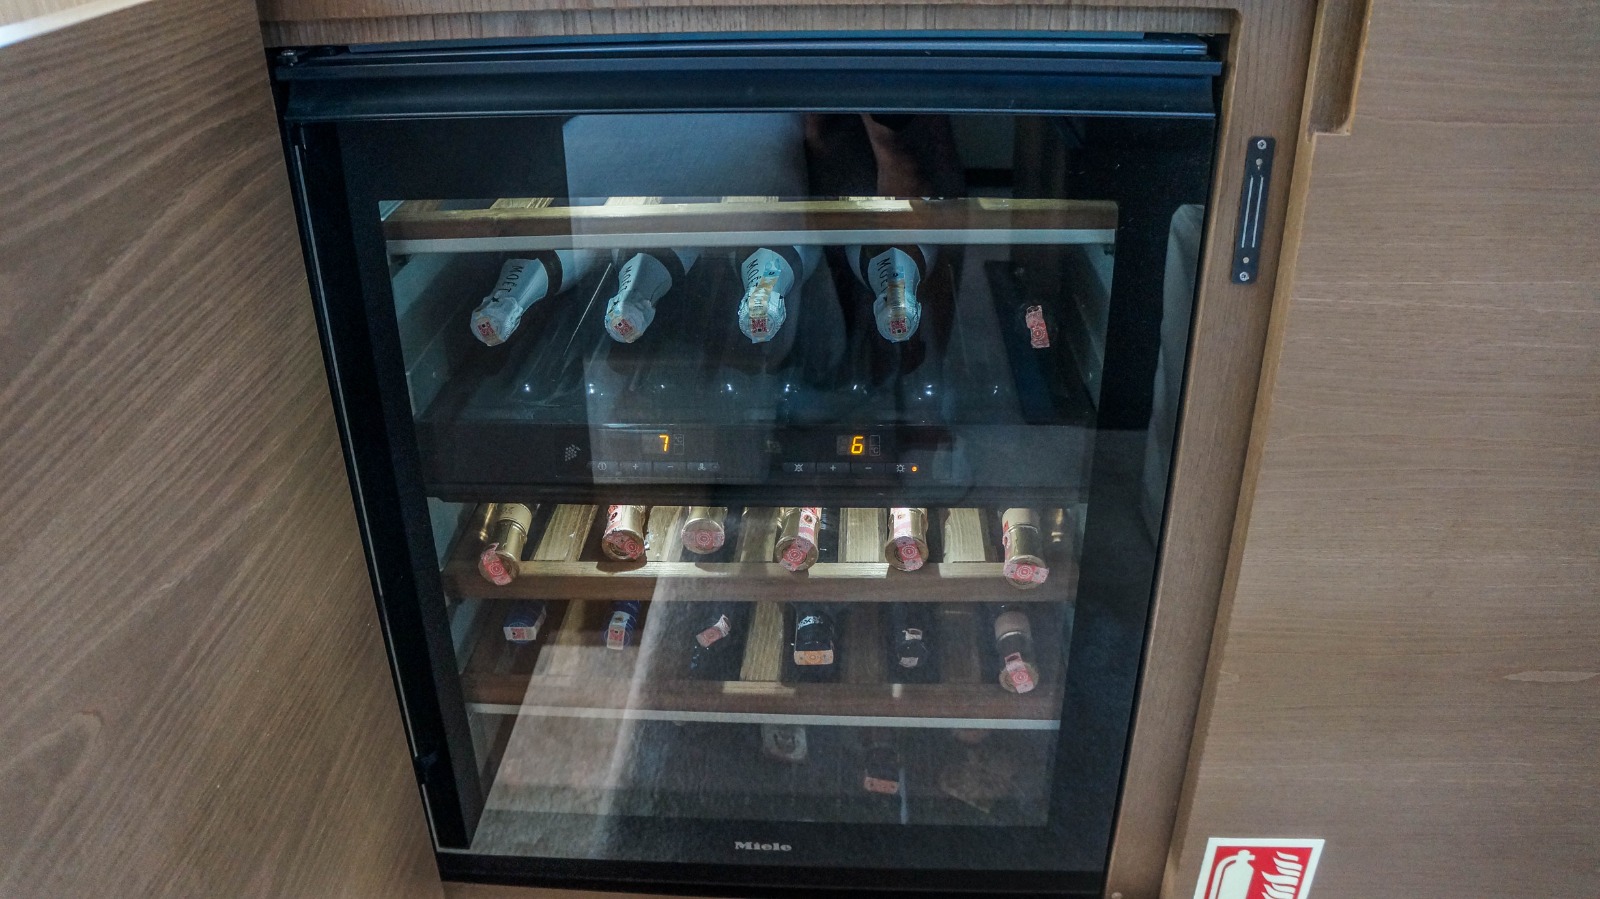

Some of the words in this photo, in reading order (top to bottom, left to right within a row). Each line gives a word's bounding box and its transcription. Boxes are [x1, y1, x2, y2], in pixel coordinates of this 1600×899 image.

[659, 434, 669, 452] 7
[851, 435, 864, 454] 6
[734, 841, 792, 851] Miele
